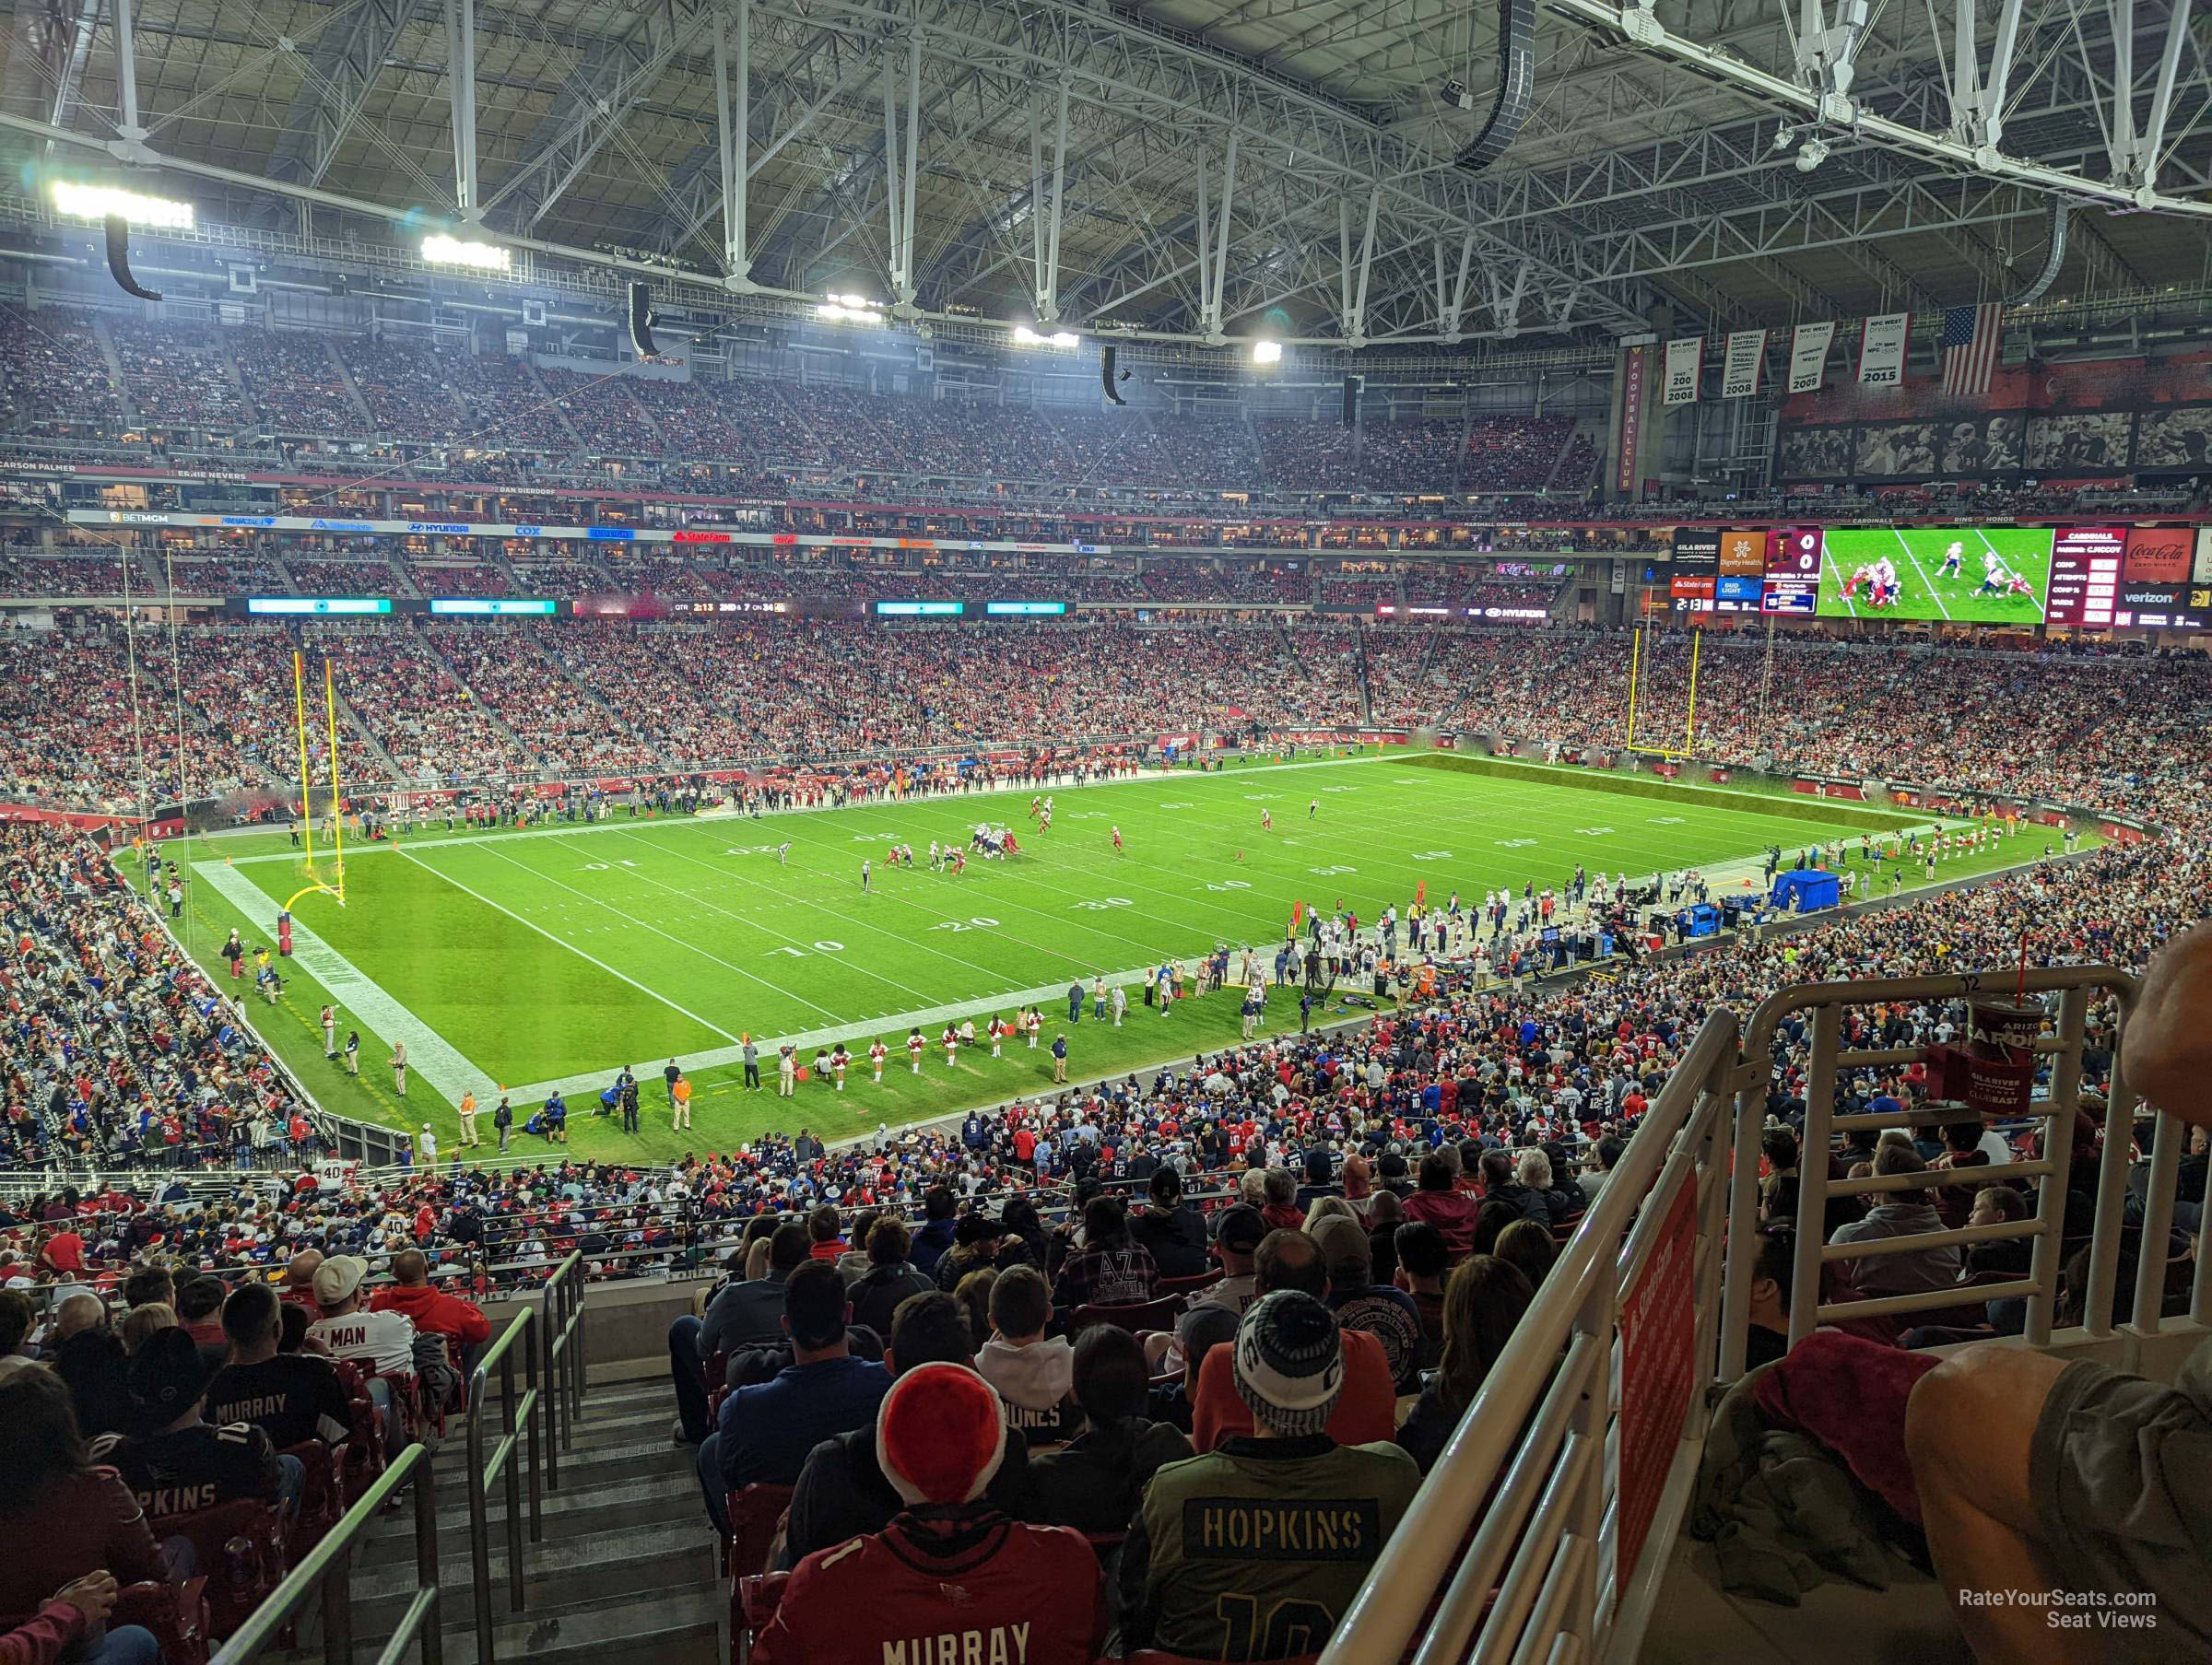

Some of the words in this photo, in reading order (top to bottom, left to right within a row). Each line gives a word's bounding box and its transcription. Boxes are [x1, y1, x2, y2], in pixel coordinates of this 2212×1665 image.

[1870, 324, 1901, 333] DIVISION
[1864, 371, 1896, 382] 2015
[1726, 384, 1751, 394] 2008
[1793, 378, 1817, 389] 2009
[1668, 391, 1693, 401] 2008
[1627, 362, 1638, 444] FOOTBALL
[38, 463, 76, 472] PALMER
[209, 472, 246, 480] NEVERS
[123, 513, 168, 523] BETMGM
[425, 524, 469, 533] HYUNDAI
[515, 527, 541, 535] COX
[1800, 534, 1815, 550] 0
[1800, 554, 1813, 569] 0
[2125, 592, 2172, 603] verizon
[1677, 598, 1701, 610] 2:13
[1502, 610, 1546, 618] HYUNDAI
[853, 832, 902, 842] 30
[727, 845, 779, 855] 20
[1411, 851, 1453, 860] 40
[585, 860, 642, 870] 10
[1308, 865, 1358, 876] 50
[1206, 879, 1253, 892] 40
[1077, 897, 1133, 910] 30
[939, 917, 1000, 932] 20
[777, 941, 845, 958] 10
[1961, 976, 1981, 991] 12
[1970, 1026, 2036, 1046] ARDI
[1412, 1098, 1420, 1108] 10
[971, 1123, 977, 1133] 9
[993, 1132, 1003, 1143] 10
[324, 1167, 340, 1179] 40
[1114, 1165, 1126, 1177] 12
[453, 1187, 465, 1197] 54
[388, 1221, 403, 1234] 40
[1099, 1252, 1138, 1284] AZ
[216, 1394, 287, 1424] MURRAY
[139, 1483, 216, 1516] PKINS
[1204, 1508, 1362, 1550] HOPKINS
[1217, 1592, 1335, 1664] 10
[882, 1622, 1030, 1665] MURRAY
